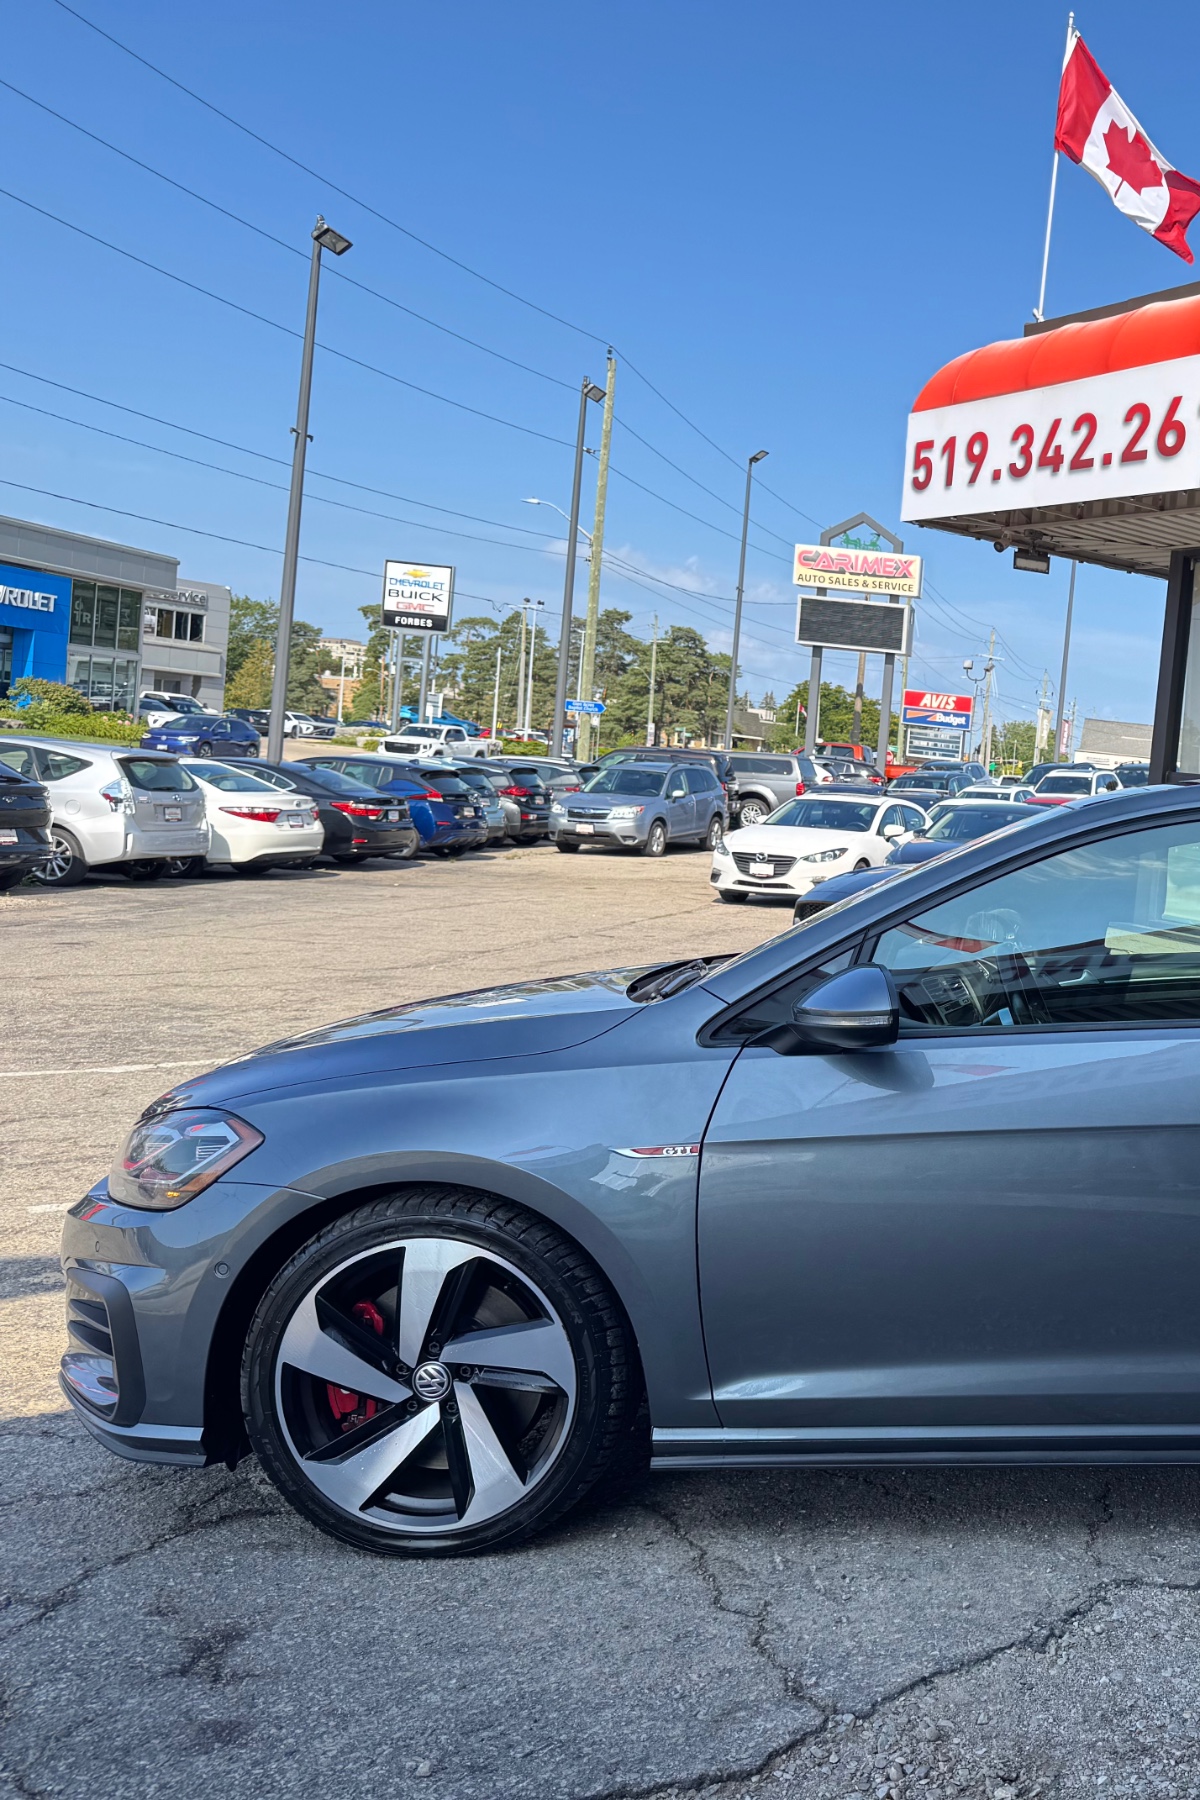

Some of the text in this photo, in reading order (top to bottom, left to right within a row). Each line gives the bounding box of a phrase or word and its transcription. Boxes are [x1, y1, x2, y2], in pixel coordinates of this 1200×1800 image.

[797, 549, 916, 578] CARIMEX
[389, 577, 445, 590] CHEVROLET
[797, 573, 914, 593] AUTO SALES & SERVICE
[388, 588, 444, 602] BUICK
[396, 601, 435, 613] GMC
[394, 616, 433, 627] FORBES
[920, 693, 957, 710] AVIS
[936, 713, 966, 726] Budget
[662, 1146, 692, 1156] GTI
